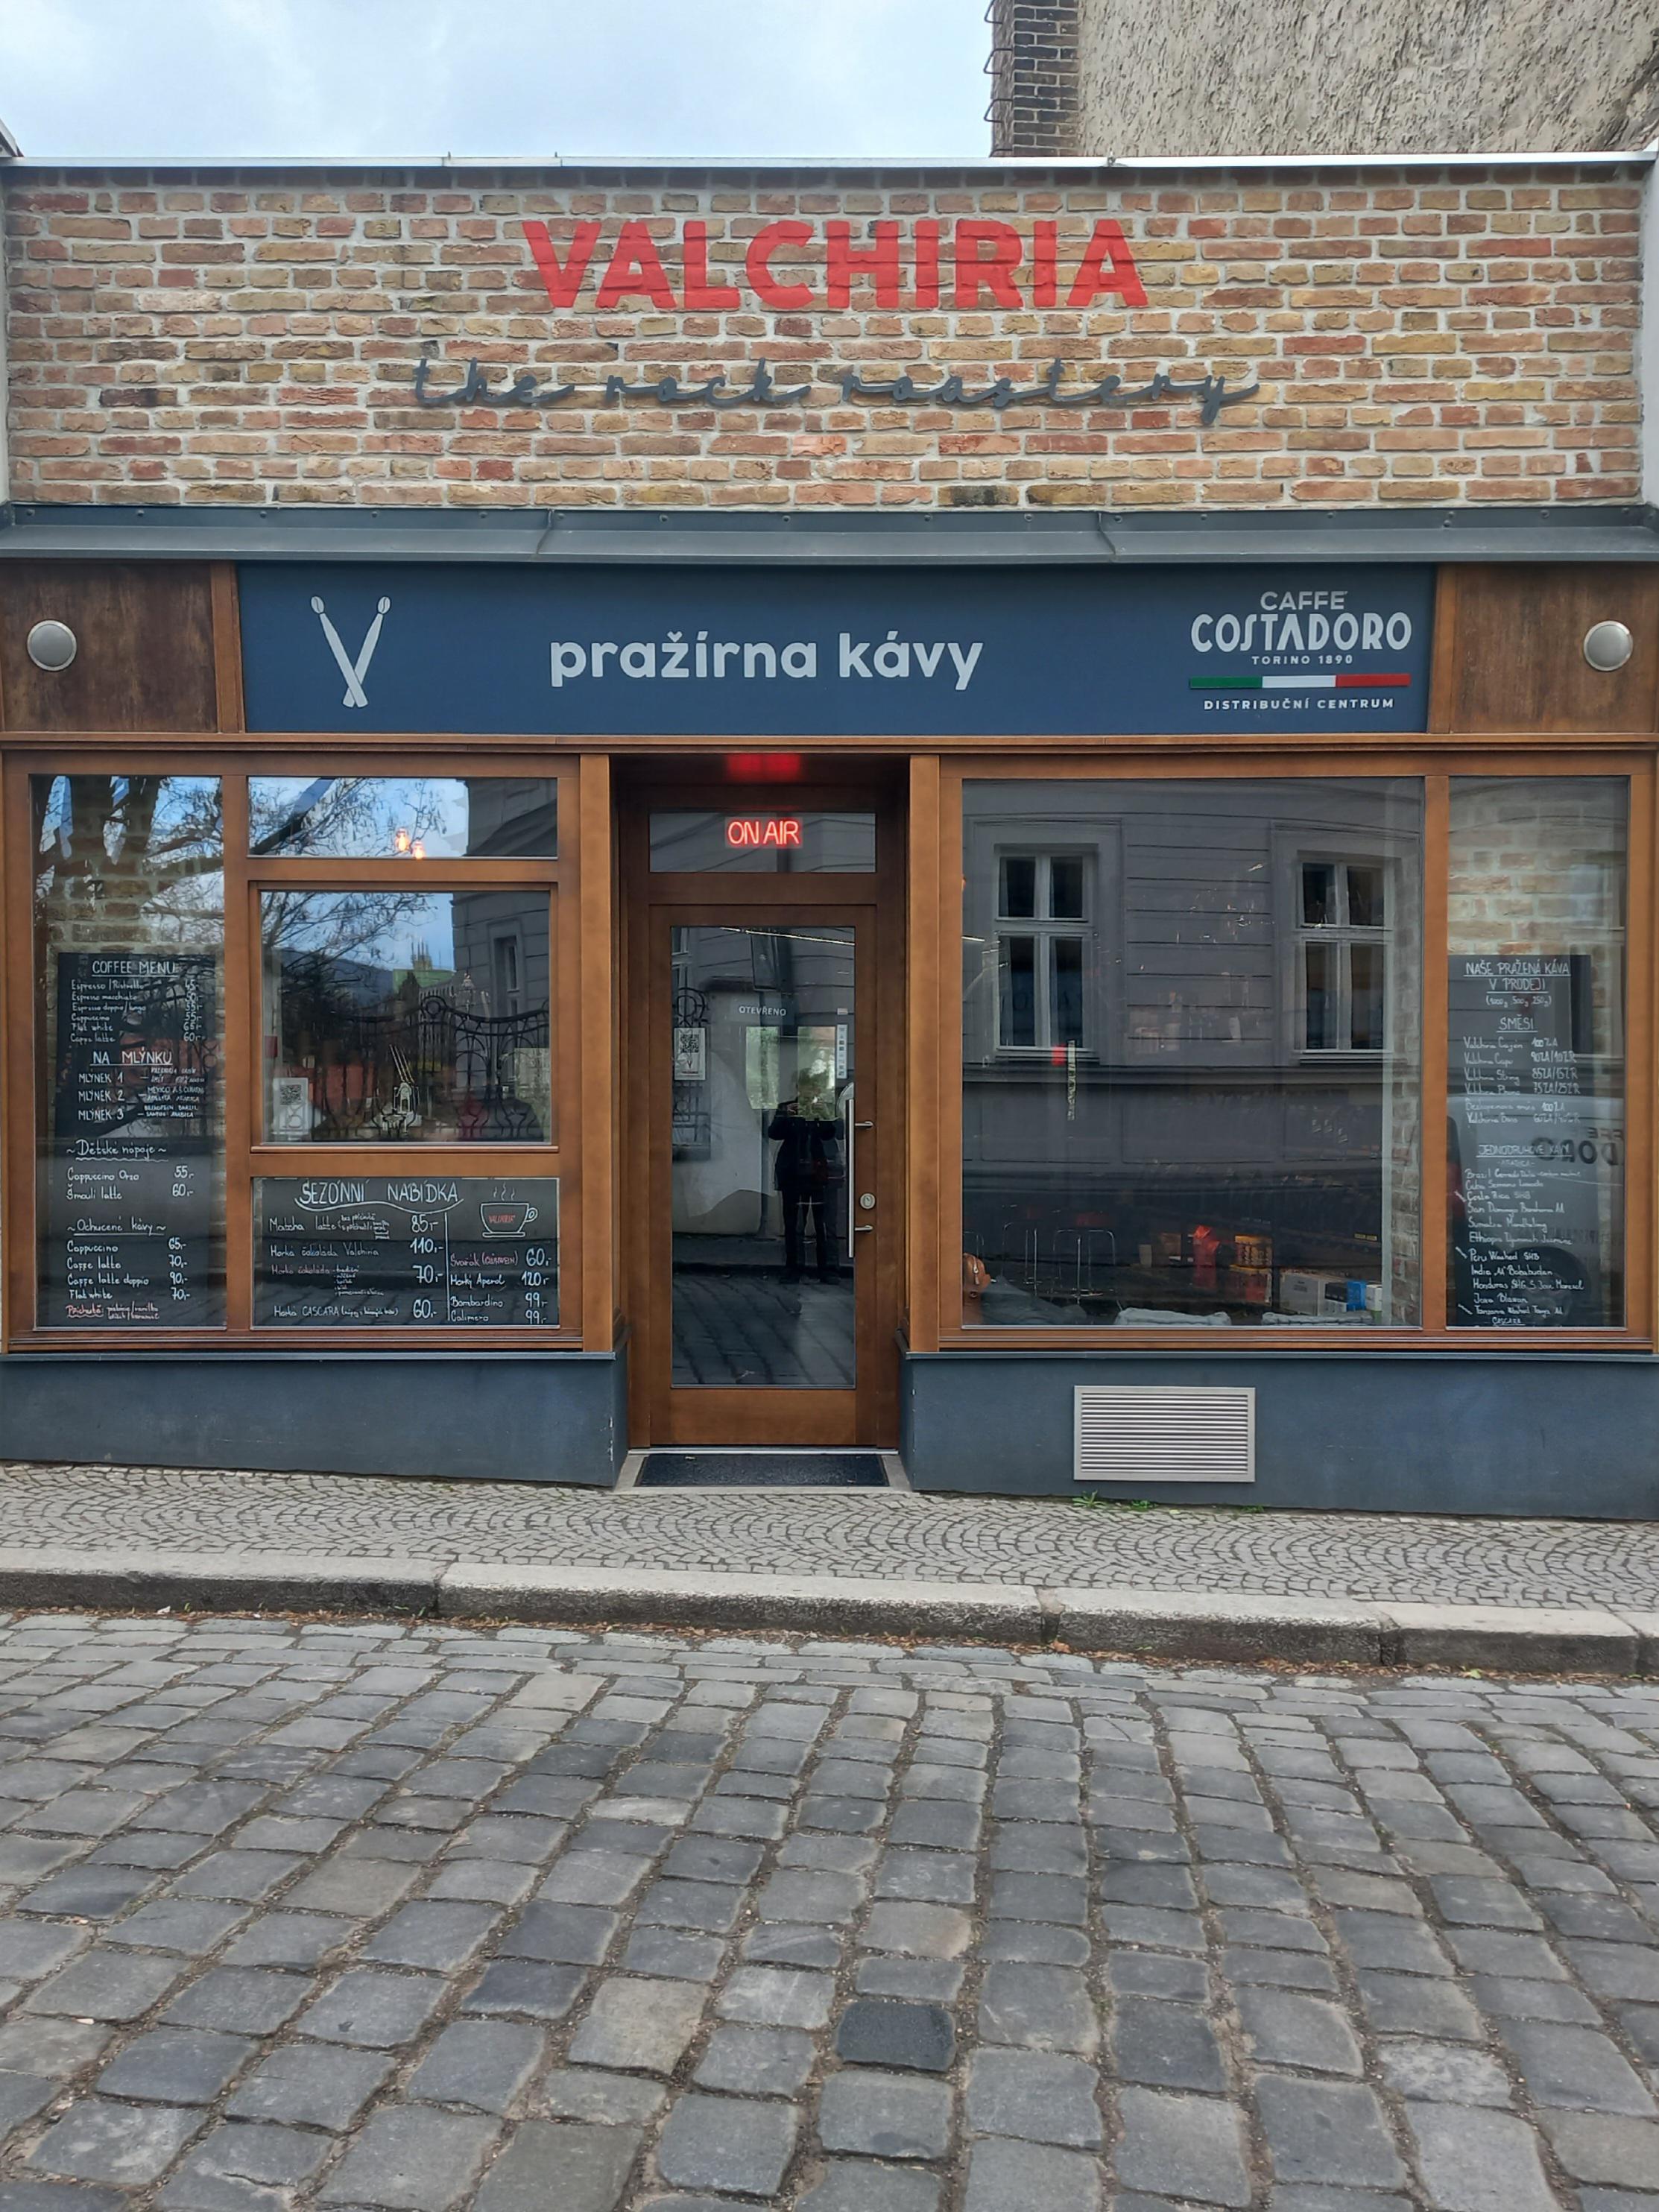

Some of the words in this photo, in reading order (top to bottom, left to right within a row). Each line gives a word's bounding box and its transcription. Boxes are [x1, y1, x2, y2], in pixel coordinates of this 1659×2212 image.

[522, 218, 1149, 309] VALCHIRIA
[412, 358, 573, 406] the
[605, 358, 811, 405] rock
[842, 358, 1260, 426] roastery
[1191, 612, 1412, 652] COSTADORO
[551, 631, 816, 687] pražírna
[839, 631, 983, 691] kávy
[1252, 655, 1310, 665] TORINO
[1318, 654, 1353, 664] 1890
[1204, 698, 1309, 710] DISTRIBUČNÍ
[1317, 698, 1394, 709] CENTRUM
[728, 821, 759, 844] ON
[763, 820, 800, 844] AIR
[92, 961, 132, 974] COFFEE
[139, 961, 175, 974] MENU
[1466, 960, 1492, 975] NAŠE
[1497, 959, 1541, 974] PRAŽENÁ
[1545, 958, 1570, 974] KÁVA
[72, 979, 106, 991] Espresso
[1489, 979, 1497, 990] V
[1503, 978, 1546, 990] PRODEJI
[739, 1006, 787, 1016] OTEVŘENO
[1499, 1014, 1534, 1031] SMĚSI
[93, 1052, 110, 1064] NA
[122, 1046, 172, 1064] MLÝNKU
[117, 1072, 124, 1083] 1
[117, 1090, 125, 1101] 2
[117, 1108, 124, 1119] 3
[67, 1167, 115, 1182] Cappuccino
[119, 1170, 139, 1181] Orzo
[101, 1185, 122, 1199] latte
[387, 1182, 459, 1203] NABÍDKA
[1467, 1202, 1485, 1213] San
[78, 1216, 122, 1231] Ochucené
[131, 1217, 153, 1236] kávy
[269, 1216, 305, 1231] Matcha
[67, 1240, 118, 1254] Cappuccino
[410, 1239, 443, 1254] 110,-
[1469, 1248, 1488, 1262] Peru
[412, 1265, 443, 1283] 70,-
[1471, 1265, 1491, 1275] India
[98, 1273, 120, 1284] latte
[476, 1274, 507, 1287] Aperol
[450, 1296, 503, 1308] Bombardino
[302, 1304, 339, 1317] CASCARA
